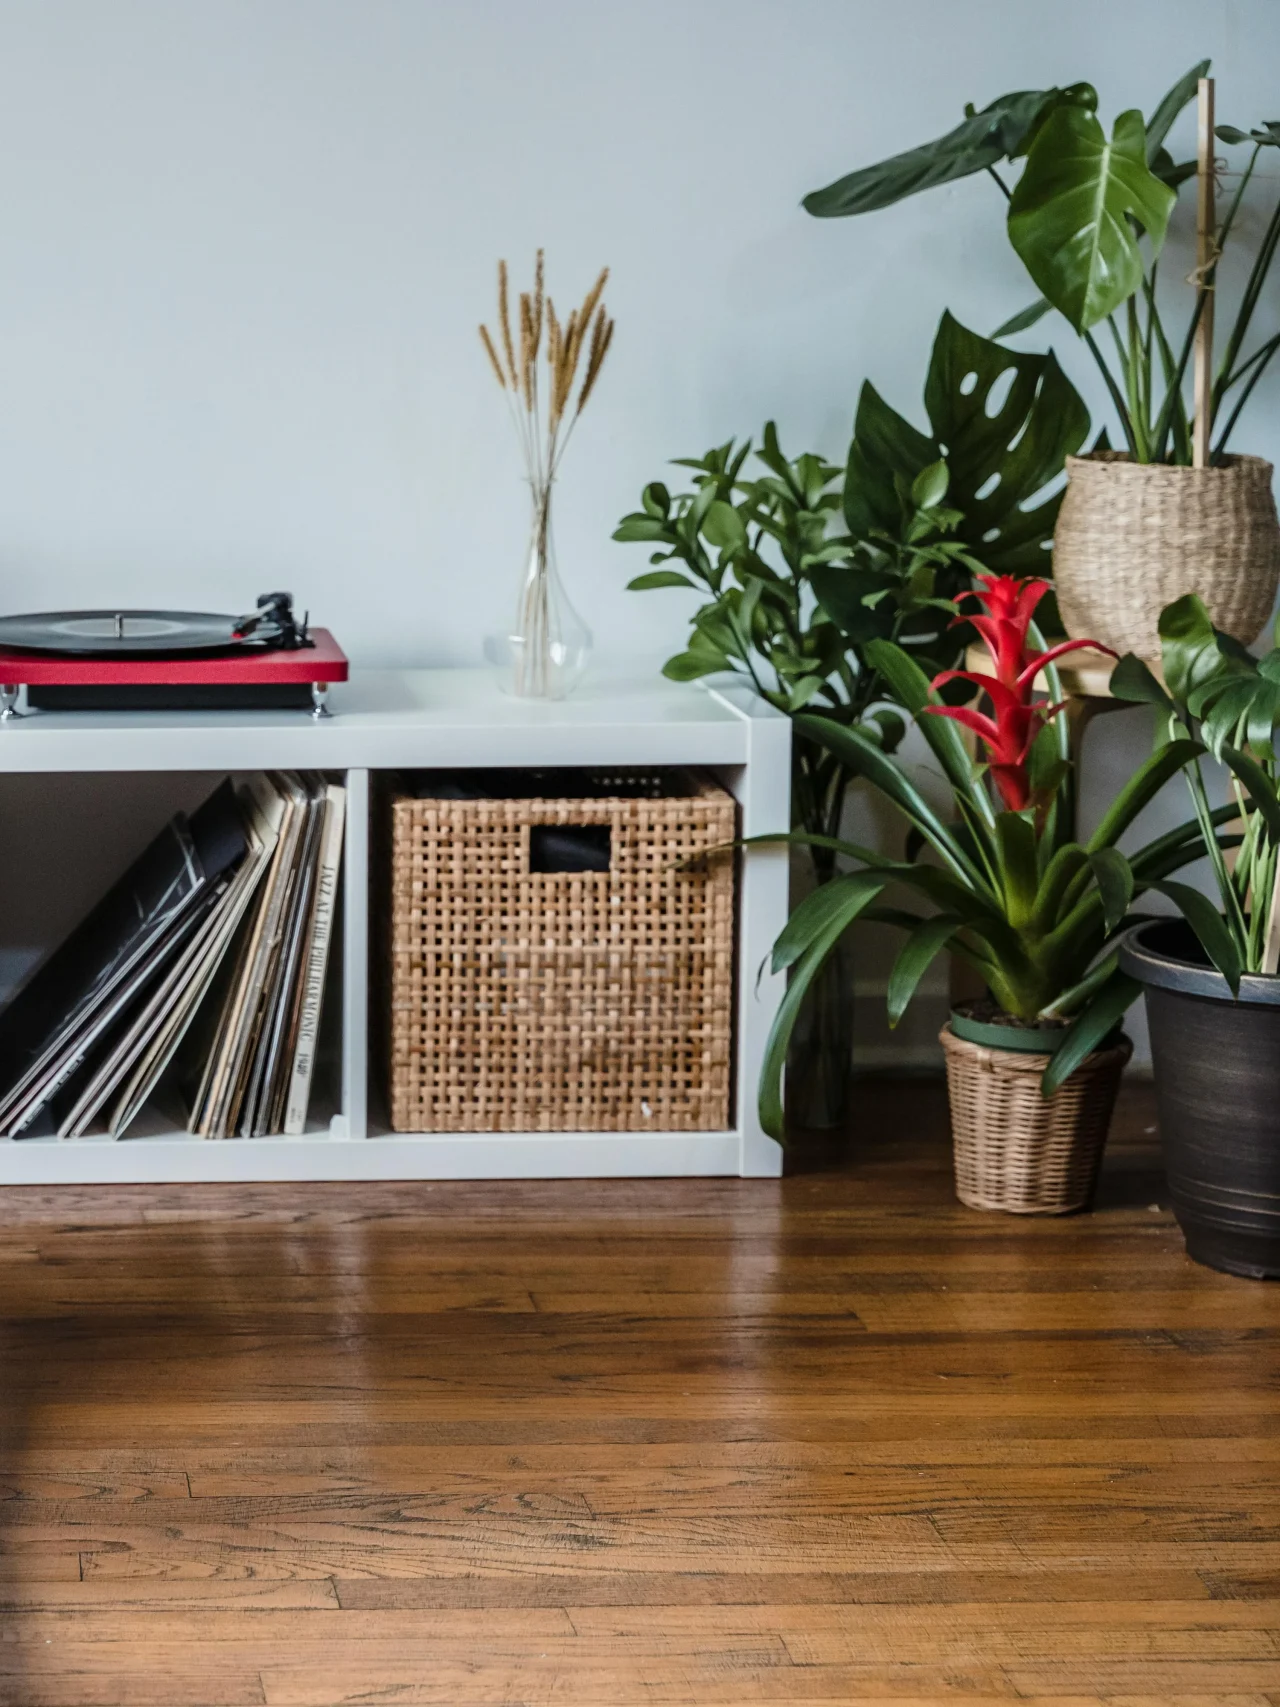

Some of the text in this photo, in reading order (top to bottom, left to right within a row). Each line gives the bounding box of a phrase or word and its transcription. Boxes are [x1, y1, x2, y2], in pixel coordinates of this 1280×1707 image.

[319, 863, 336, 896] JAZZ
[316, 899, 329, 914] AT
[313, 919, 328, 940] THE
[300, 945, 325, 1041] PHILHARMONIC
